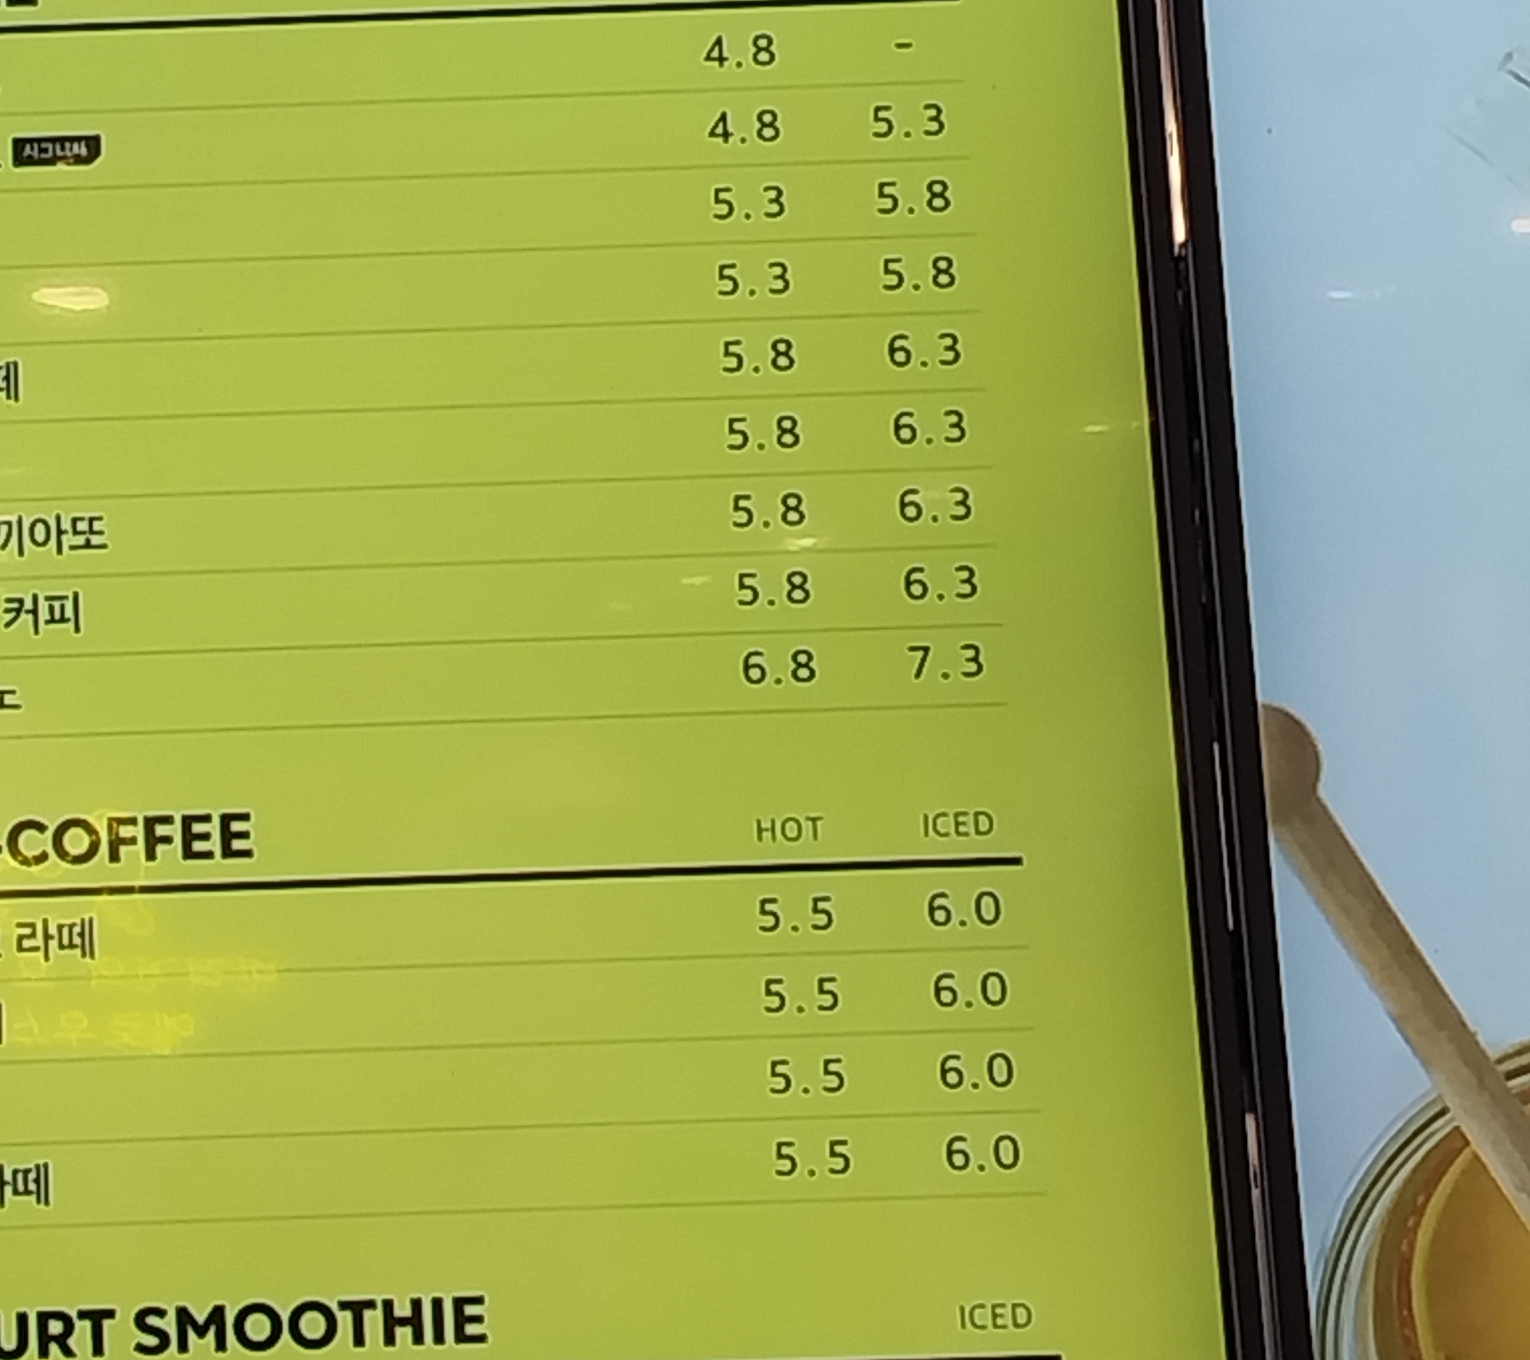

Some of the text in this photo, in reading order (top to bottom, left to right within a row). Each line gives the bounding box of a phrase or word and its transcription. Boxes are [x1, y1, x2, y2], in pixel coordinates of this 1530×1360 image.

[704, 34, 775, 68] 4.8
[709, 104, 944, 143] 4.8 5.3
[713, 180, 950, 220] 5.3 5.8
[718, 257, 955, 296] 5.3 5.8
[723, 333, 960, 373] 5.8 6.3
[728, 410, 965, 450] 5.8 6.3
[733, 487, 971, 528] 5.8 6.3
[738, 565, 977, 605] 5.8 6.3
[3, 592, 80, 635] 커피
[743, 644, 983, 684] 6.8 7.3
[757, 811, 993, 843] HOT ICED
[759, 892, 1001, 932] 5.5 6.0
[16, 917, 94, 962] 라떼
[765, 972, 1007, 1013] 5.5 6.0
[770, 1053, 1013, 1094] 5.5 6.0
[776, 1135, 1019, 1177] 5.5 6.0
[134, 1295, 487, 1355] SMOOTHIE
[960, 1303, 1032, 1330] ICED
